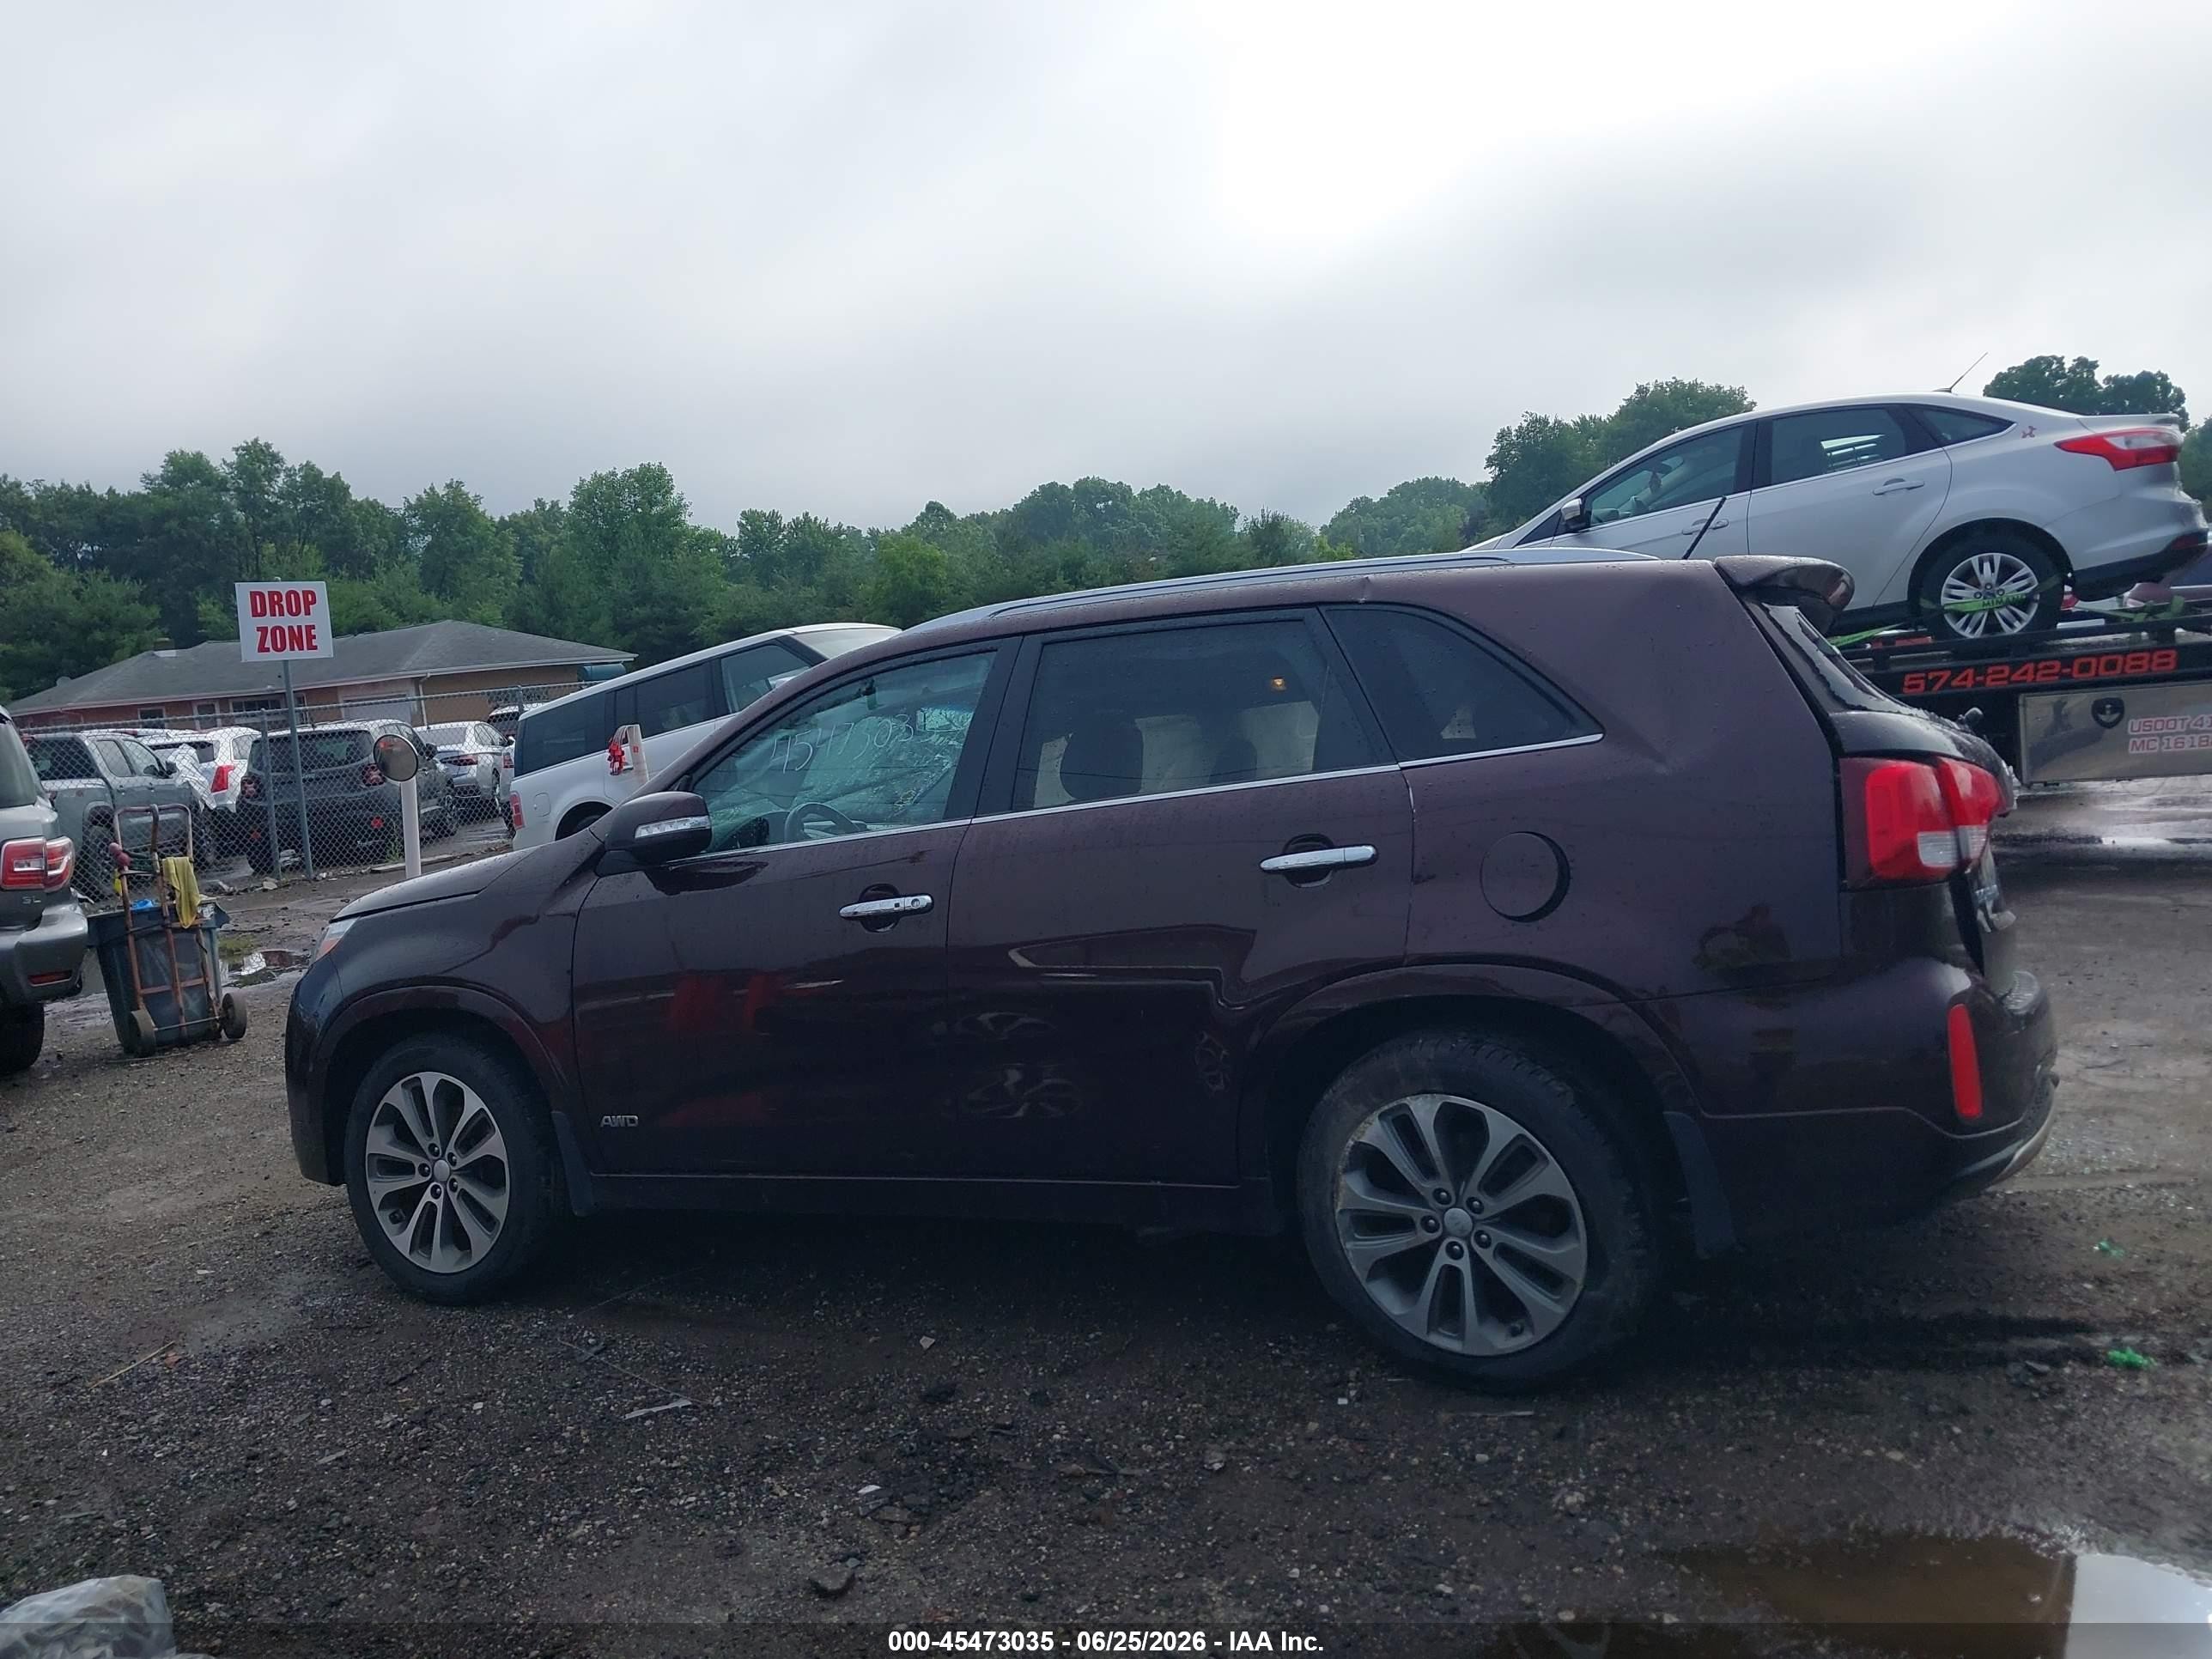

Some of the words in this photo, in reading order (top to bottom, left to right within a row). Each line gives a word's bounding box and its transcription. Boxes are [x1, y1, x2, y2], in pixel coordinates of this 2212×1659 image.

[249, 589, 317, 617] DROP
[256, 624, 318, 653] ZONE
[2129, 716, 2191, 734] USDOT
[2130, 738, 2158, 752] MC
[2162, 734, 2212, 750] 1618
[22, 896, 41, 904] SL
[600, 1115, 639, 1127] AWD
